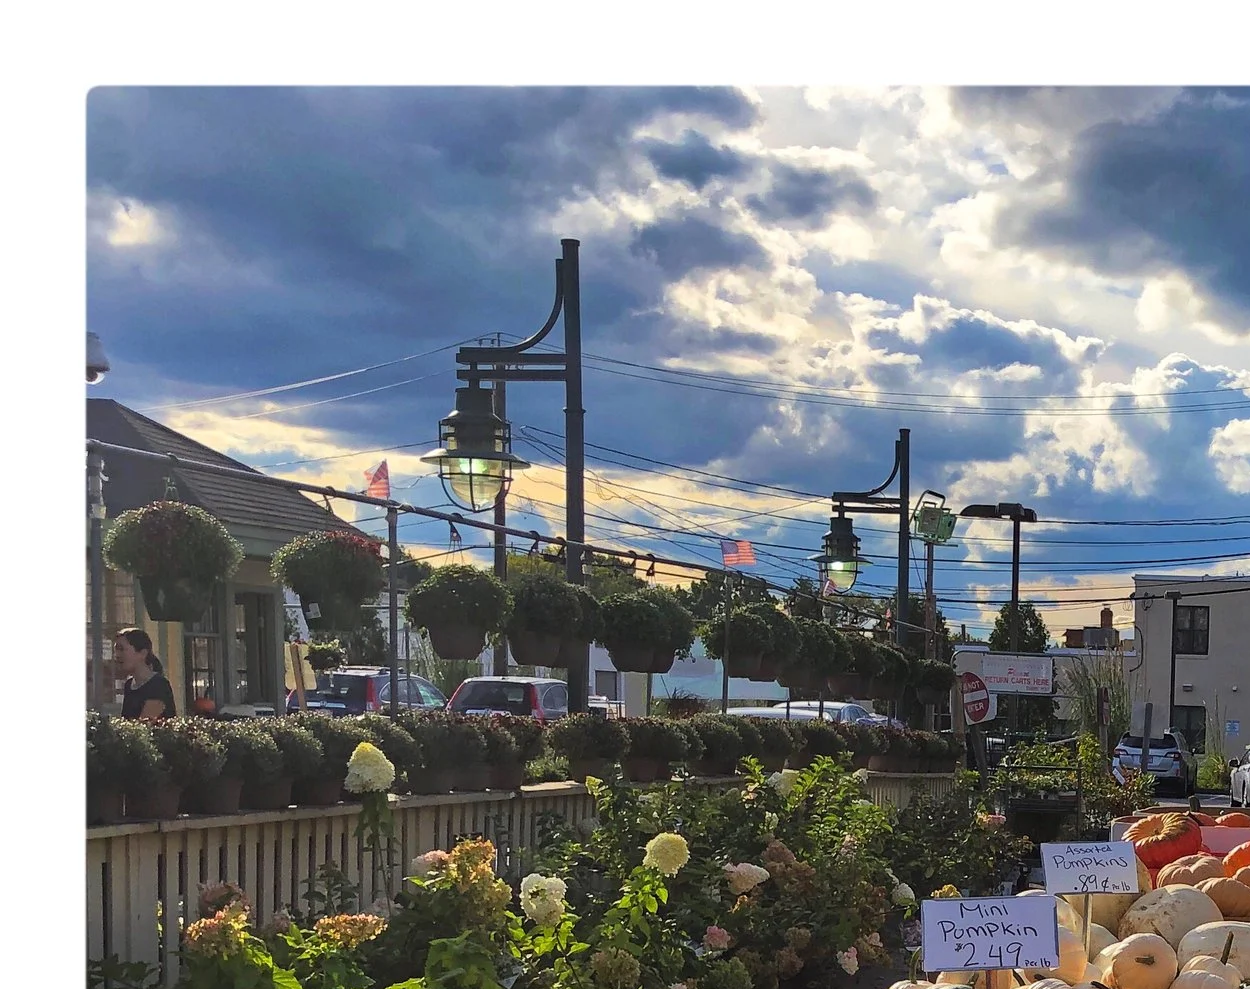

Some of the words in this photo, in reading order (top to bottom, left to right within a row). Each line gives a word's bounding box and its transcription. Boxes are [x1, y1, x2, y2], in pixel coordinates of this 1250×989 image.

[985, 676, 1008, 684] RETURN
[1011, 677, 1030, 685] CARTS
[1033, 678, 1049, 686] HERE
[1066, 845, 1112, 855] Assorted
[1052, 855, 1128, 870] Pumpkins
[1121, 881, 1131, 892] lb
[959, 901, 1007, 918] Mini
[937, 920, 1038, 942] Pumpkin
[955, 942, 1023, 967] $2.49
[1040, 957, 1051, 968] lb
